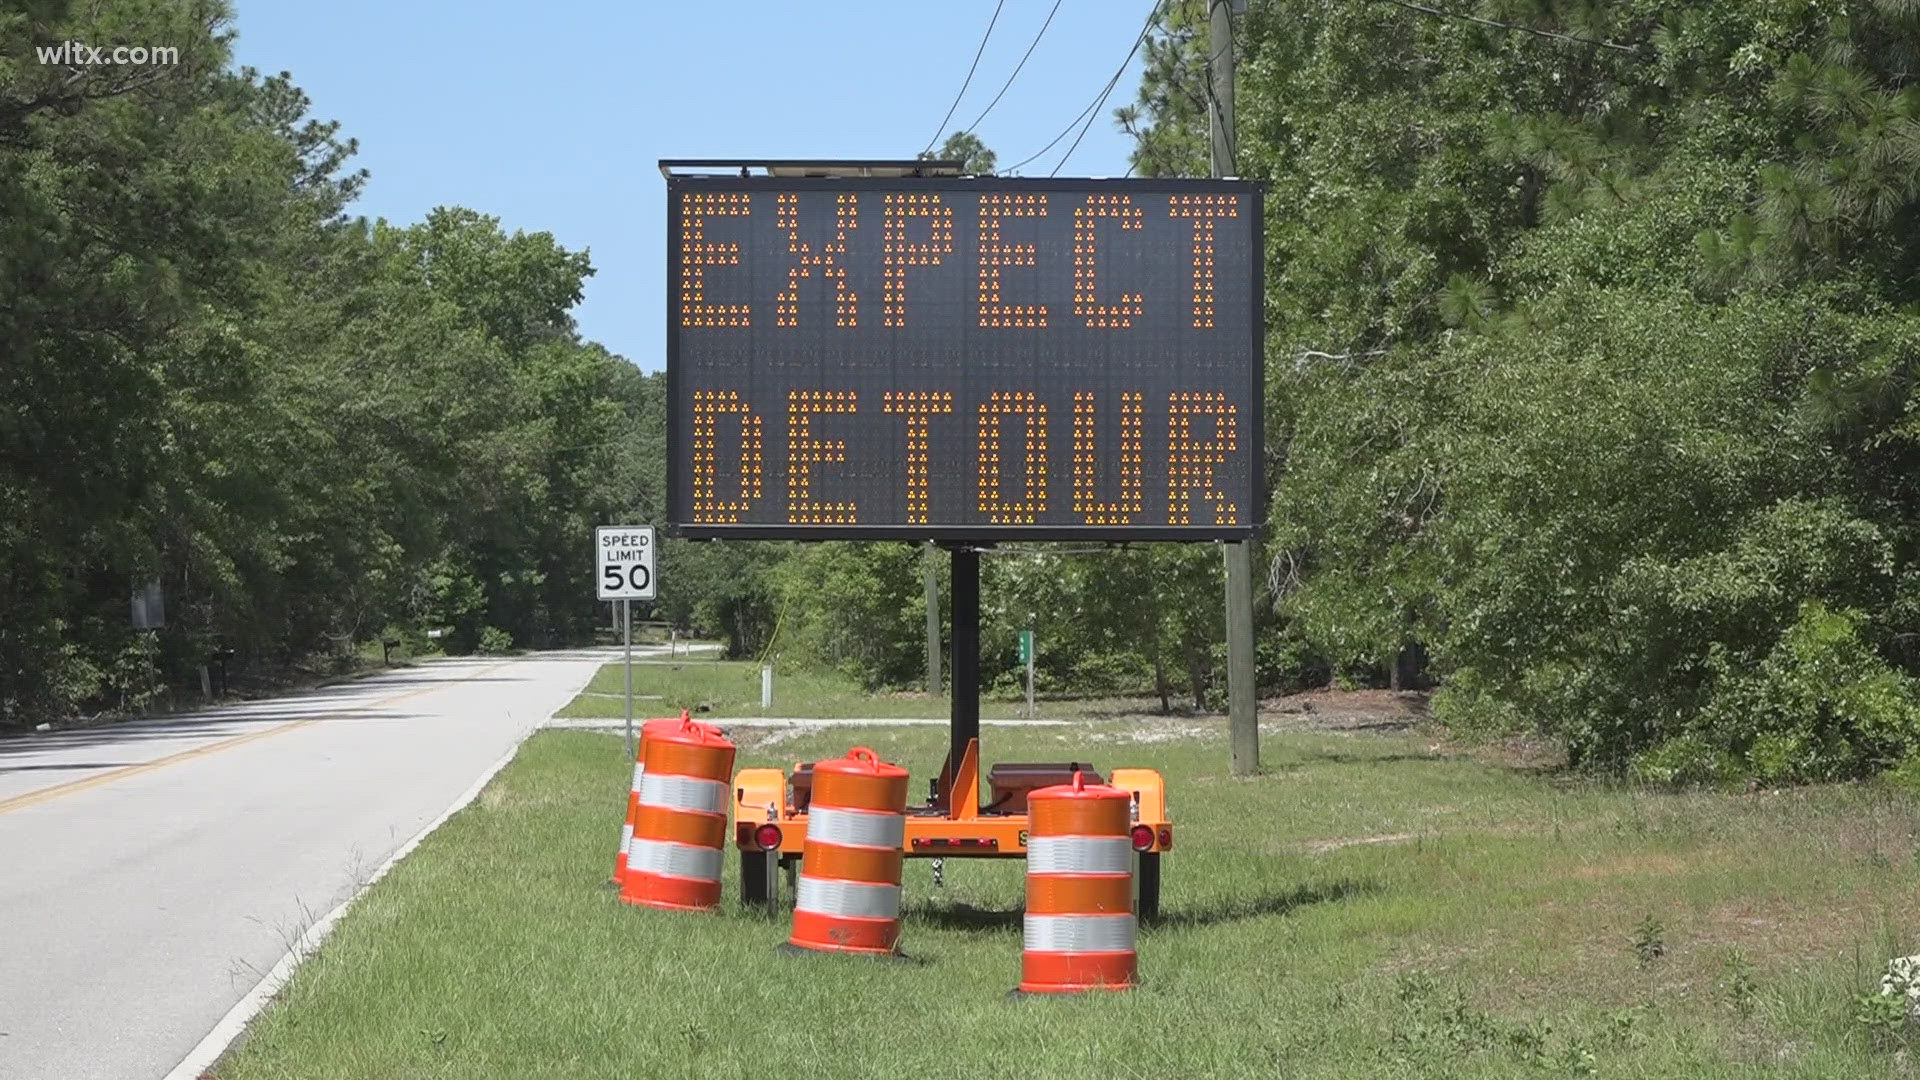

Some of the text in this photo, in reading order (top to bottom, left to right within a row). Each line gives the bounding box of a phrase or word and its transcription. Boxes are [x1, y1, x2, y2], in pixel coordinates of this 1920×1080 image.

[682, 193, 1238, 328] EXPECT
[693, 390, 1237, 525] DETOUR
[602, 535, 649, 547] SPEED
[607, 550, 644, 561] LIMIT
[604, 564, 650, 591] 50
